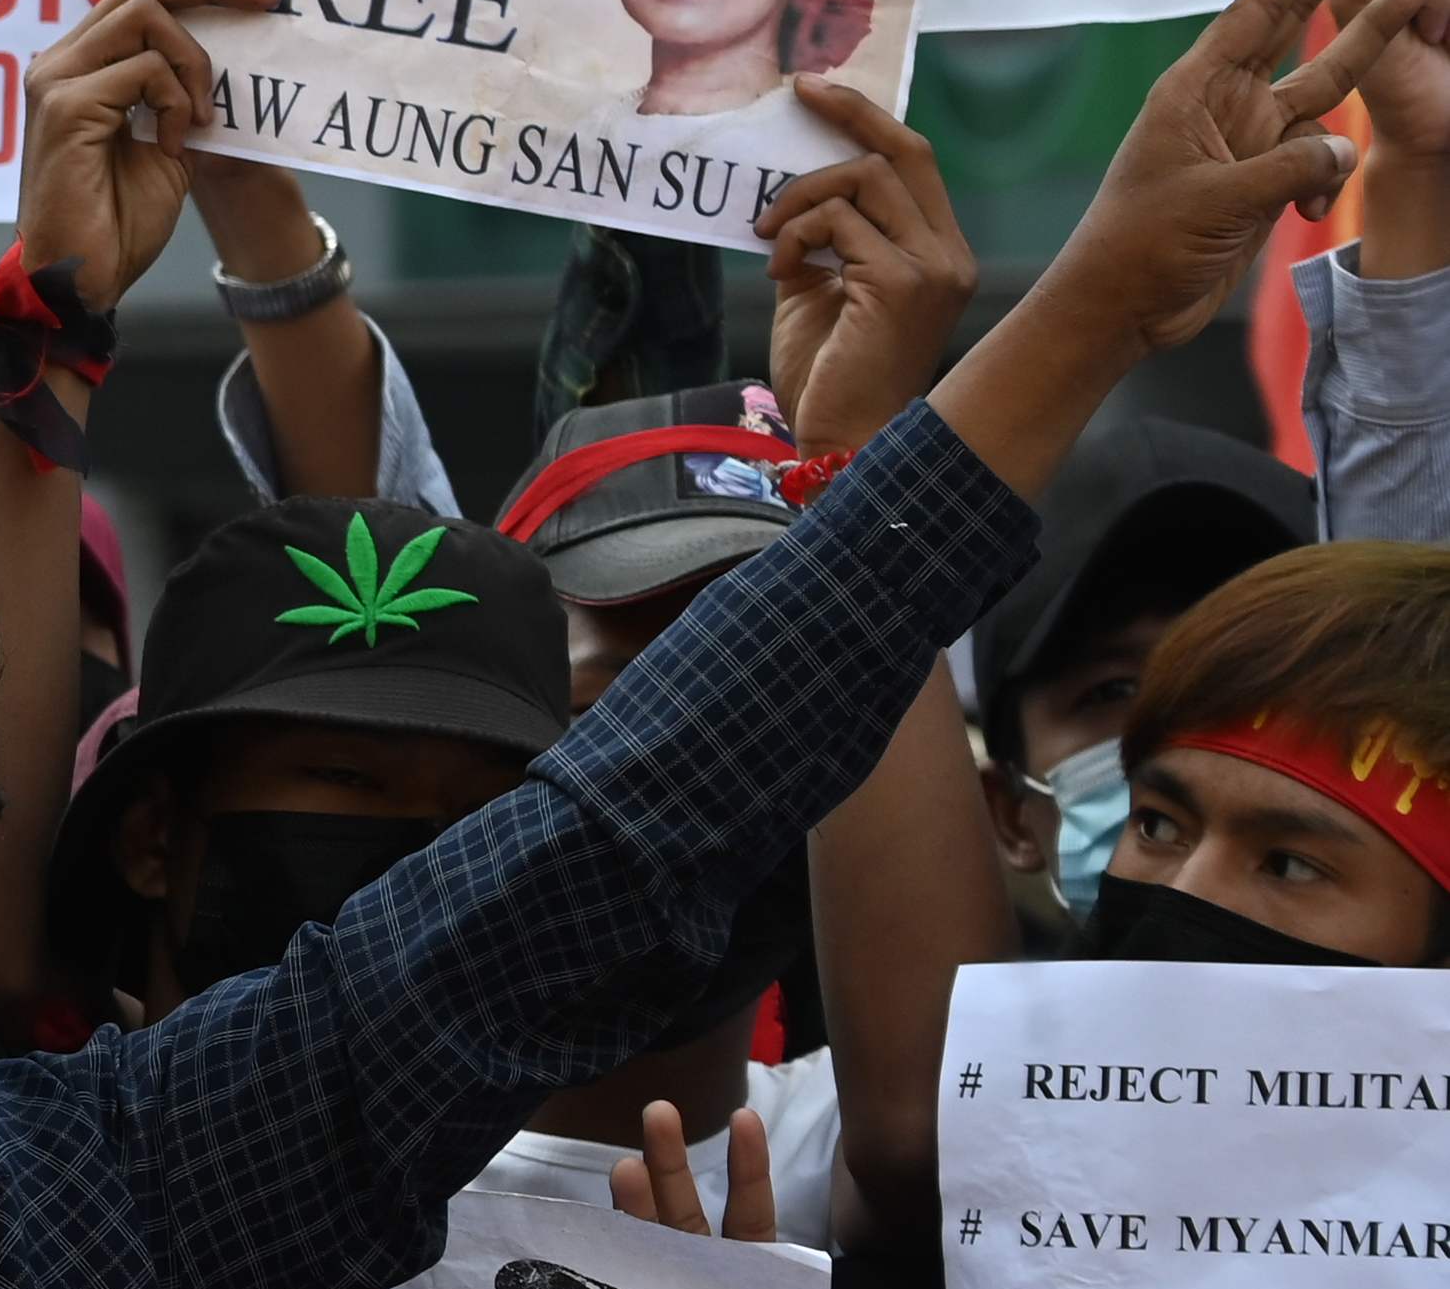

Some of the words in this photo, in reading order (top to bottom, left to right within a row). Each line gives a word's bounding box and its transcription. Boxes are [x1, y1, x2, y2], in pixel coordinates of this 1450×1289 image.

[312, 91, 497, 175] AUNG
[511, 124, 642, 202] SAN
[653, 150, 739, 218] SU
[958, 1062, 983, 1099] #
[1023, 1064, 1218, 1105] REJECT
[959, 1209, 983, 1246] #
[1019, 1210, 1148, 1252] SAVE
[1176, 1215, 1450, 1260] MYANMAR
